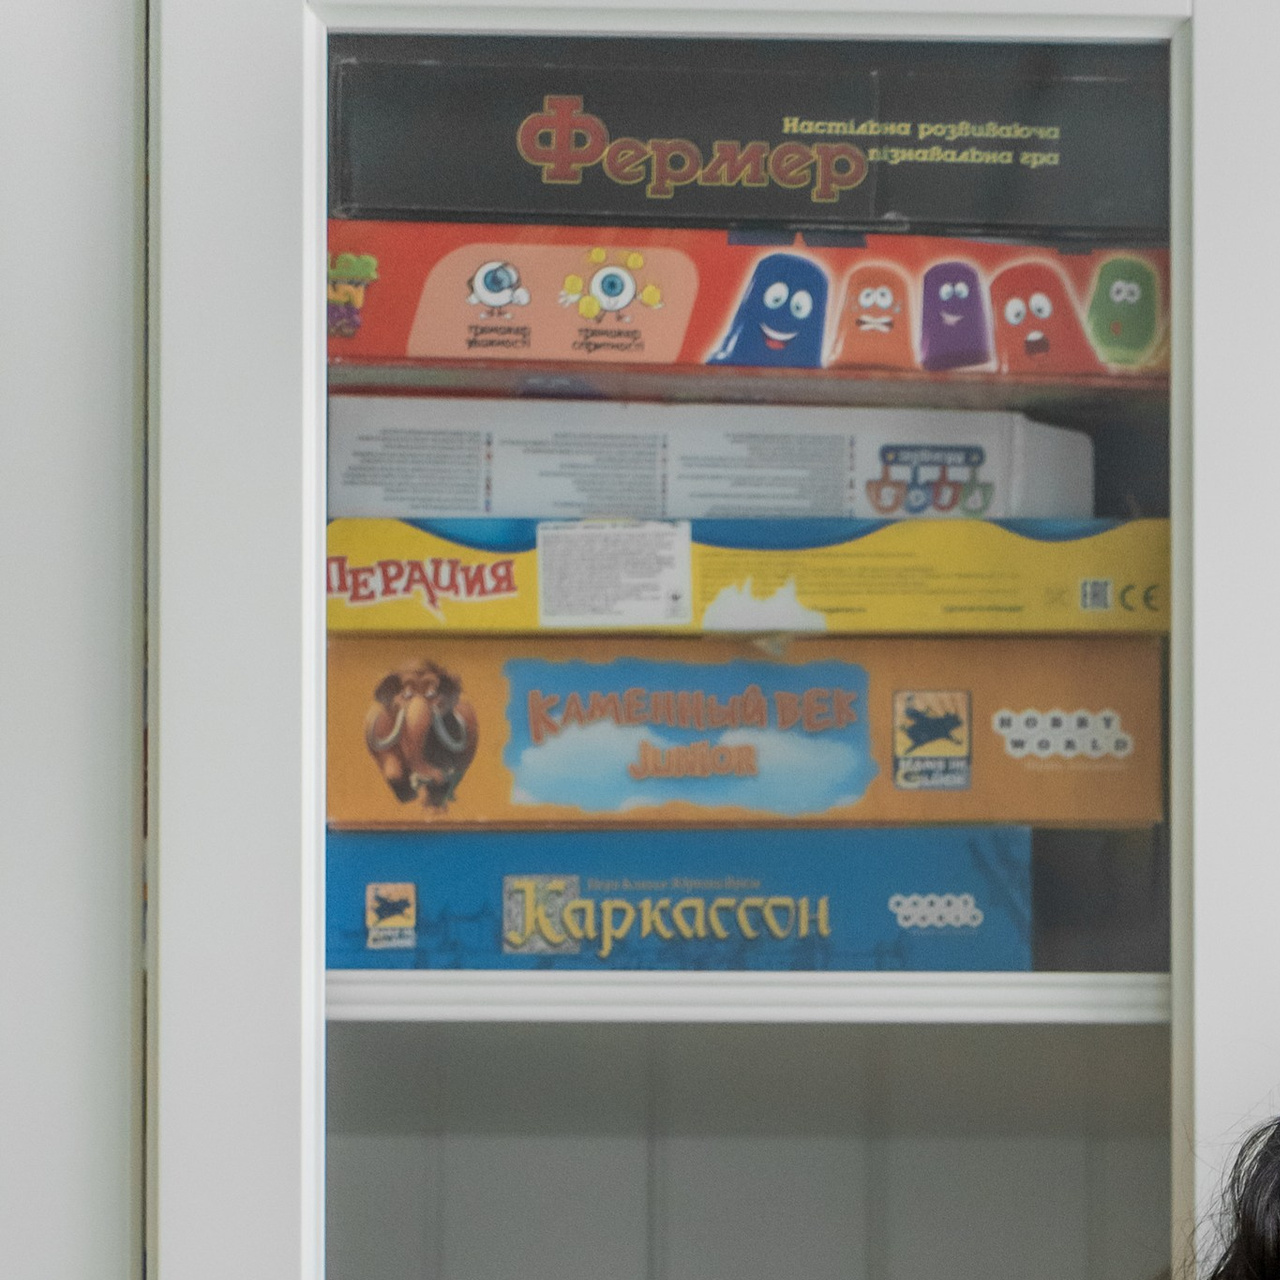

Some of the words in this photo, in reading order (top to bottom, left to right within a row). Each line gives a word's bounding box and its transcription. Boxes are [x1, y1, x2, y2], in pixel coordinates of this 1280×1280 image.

[516, 95, 868, 202] Фермер
[782, 116, 911, 136] Настільна
[918, 120, 1061, 141] розвиваюча
[1020, 151, 1060, 169] гра
[528, 683, 768, 744] КАМЕННЫЙ
[774, 686, 858, 732] ВЕК
[628, 740, 759, 780] JUNIOR
[506, 878, 833, 959] Каркассон
